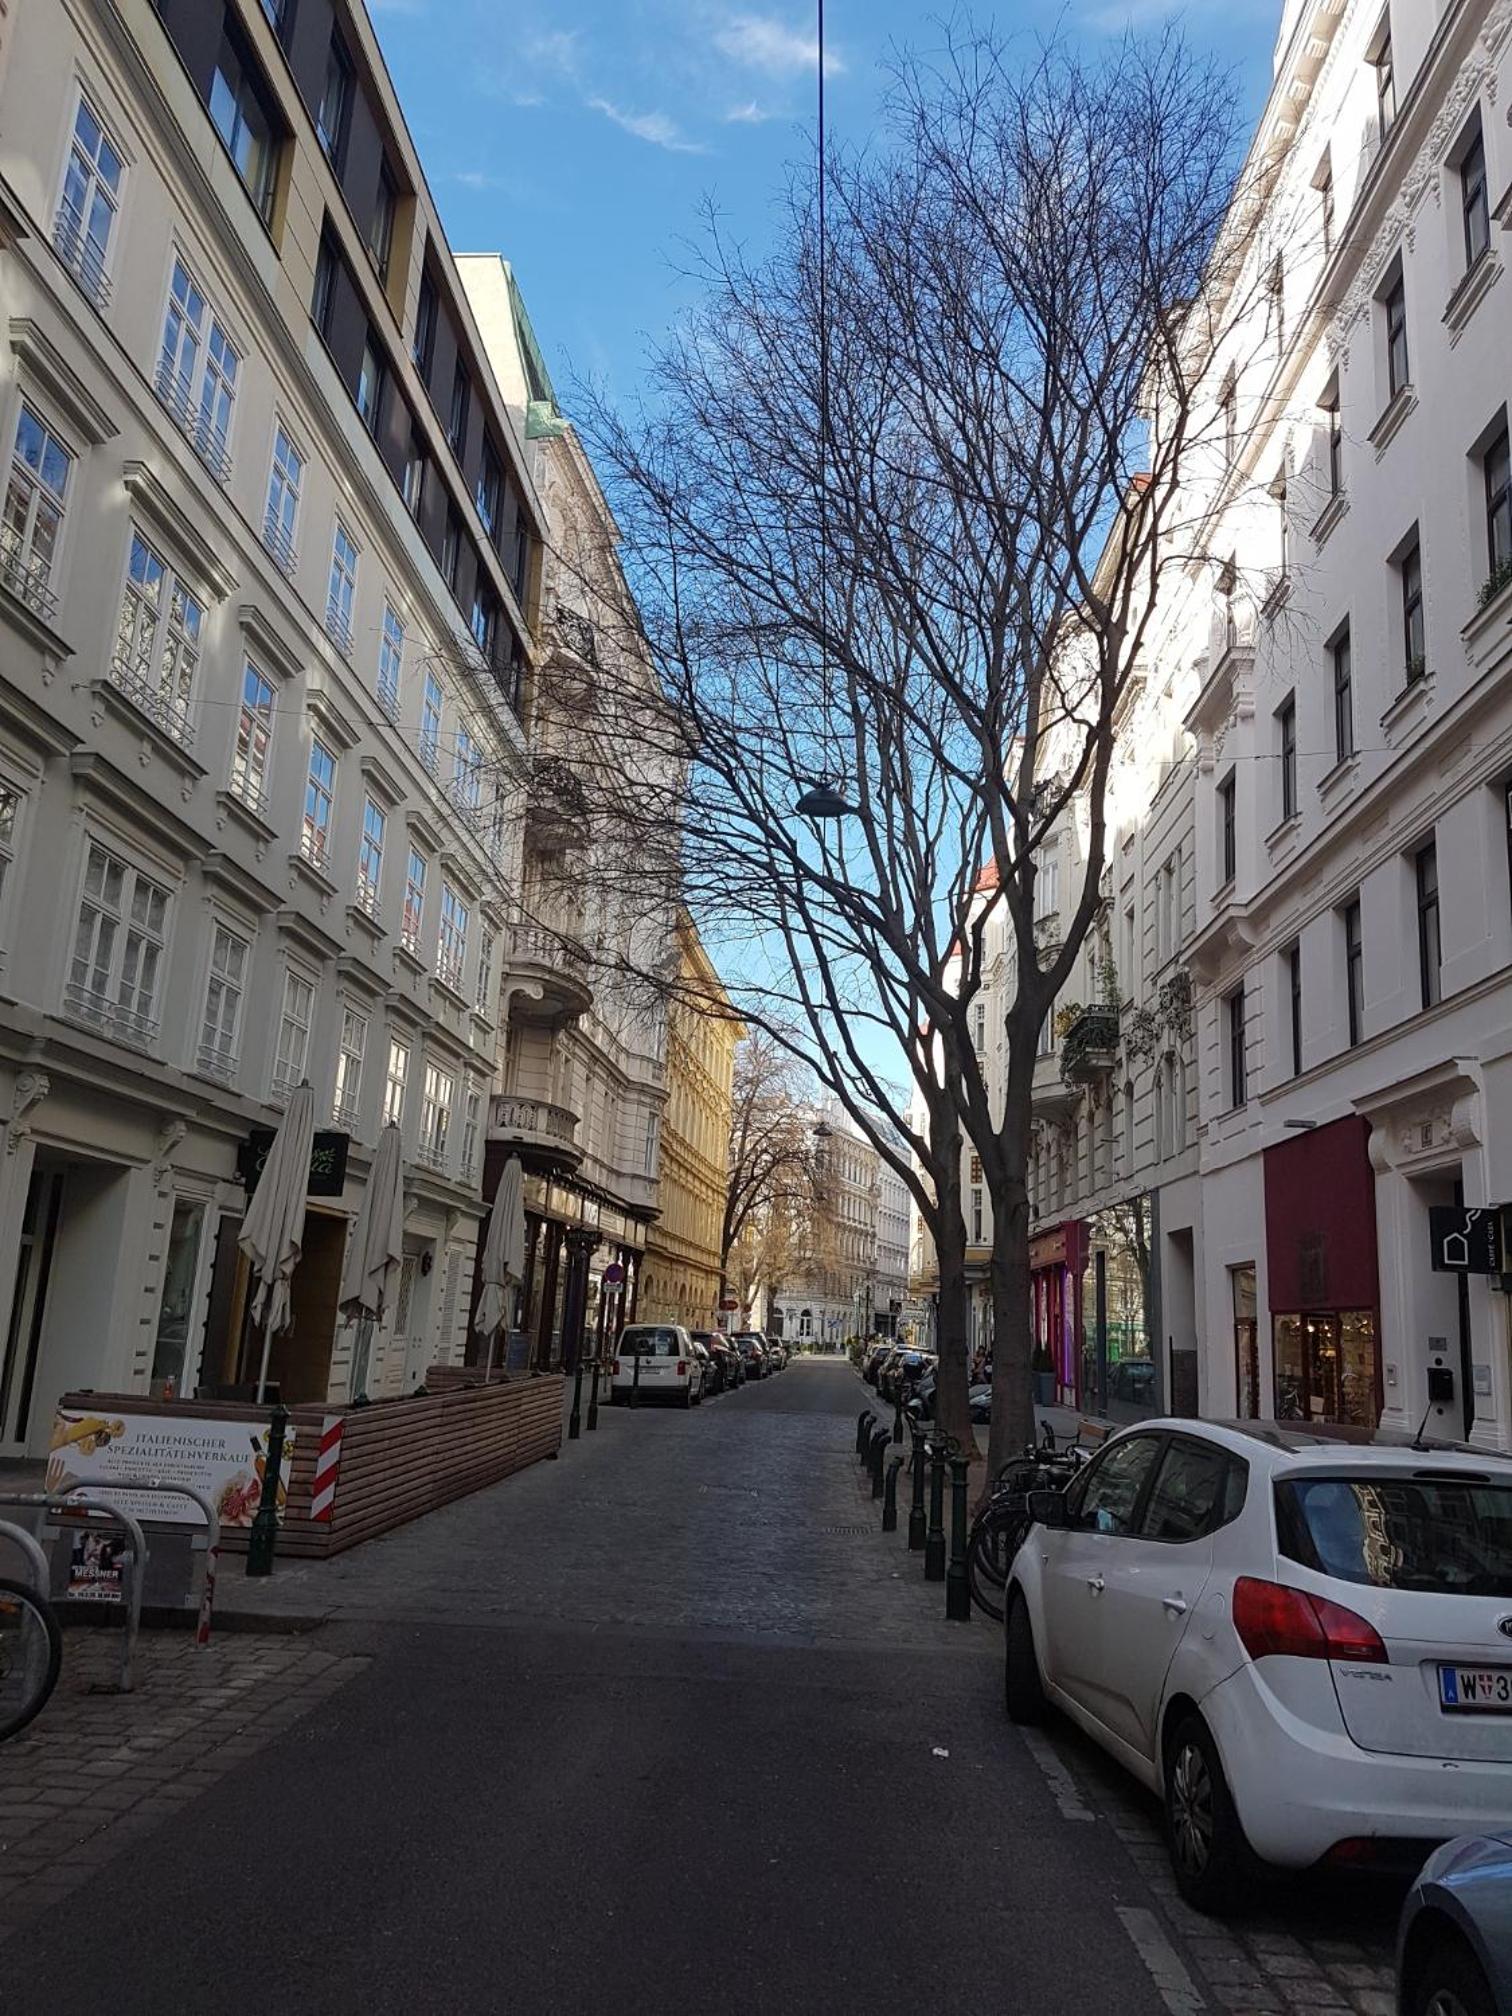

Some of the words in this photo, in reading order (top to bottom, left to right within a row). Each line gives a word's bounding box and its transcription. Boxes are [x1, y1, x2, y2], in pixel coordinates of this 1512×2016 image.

[135, 1434, 226, 1449] ITALIENISCHER
[107, 1444, 250, 1463] SPEZIALITÄTENVERKAUF
[74, 1567, 118, 1579] MESSNER
[1460, 1674, 1476, 1700] W
[1496, 1675, 1512, 1701] 3
